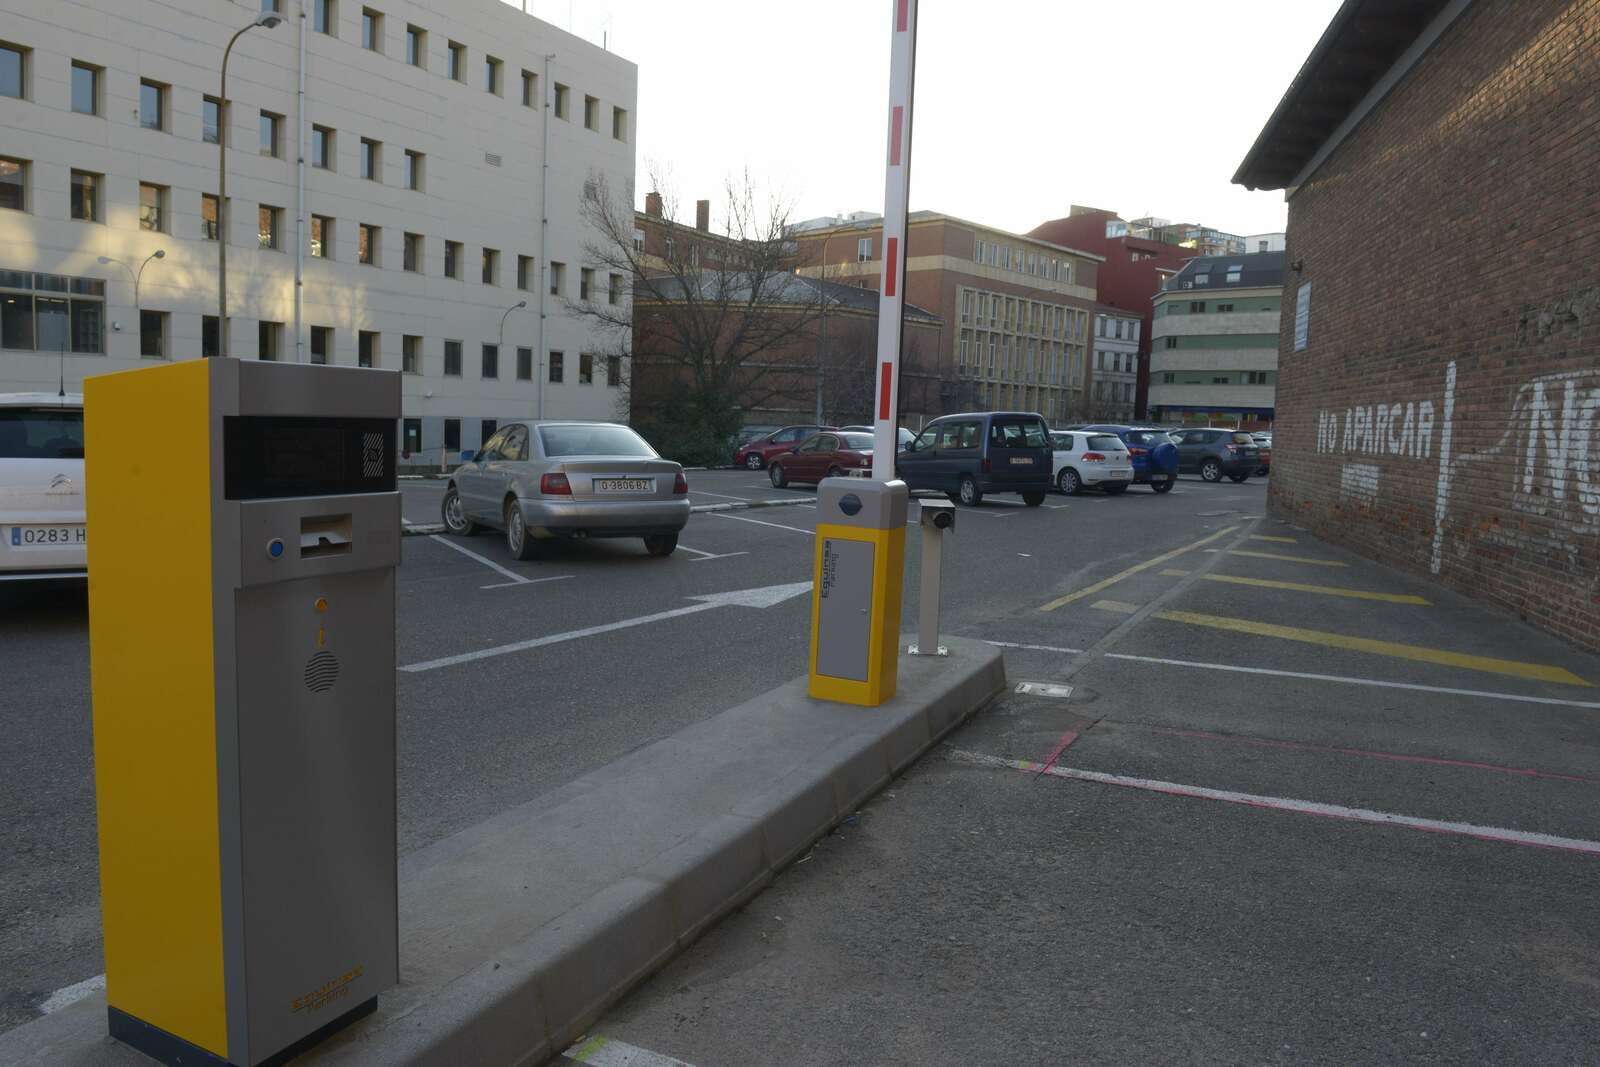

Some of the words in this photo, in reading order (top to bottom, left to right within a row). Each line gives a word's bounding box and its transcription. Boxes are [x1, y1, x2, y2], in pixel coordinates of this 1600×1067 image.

[1317, 408, 1337, 455] NO
[1342, 401, 1434, 459] APARCAR
[25, 528, 69, 543] 0283
